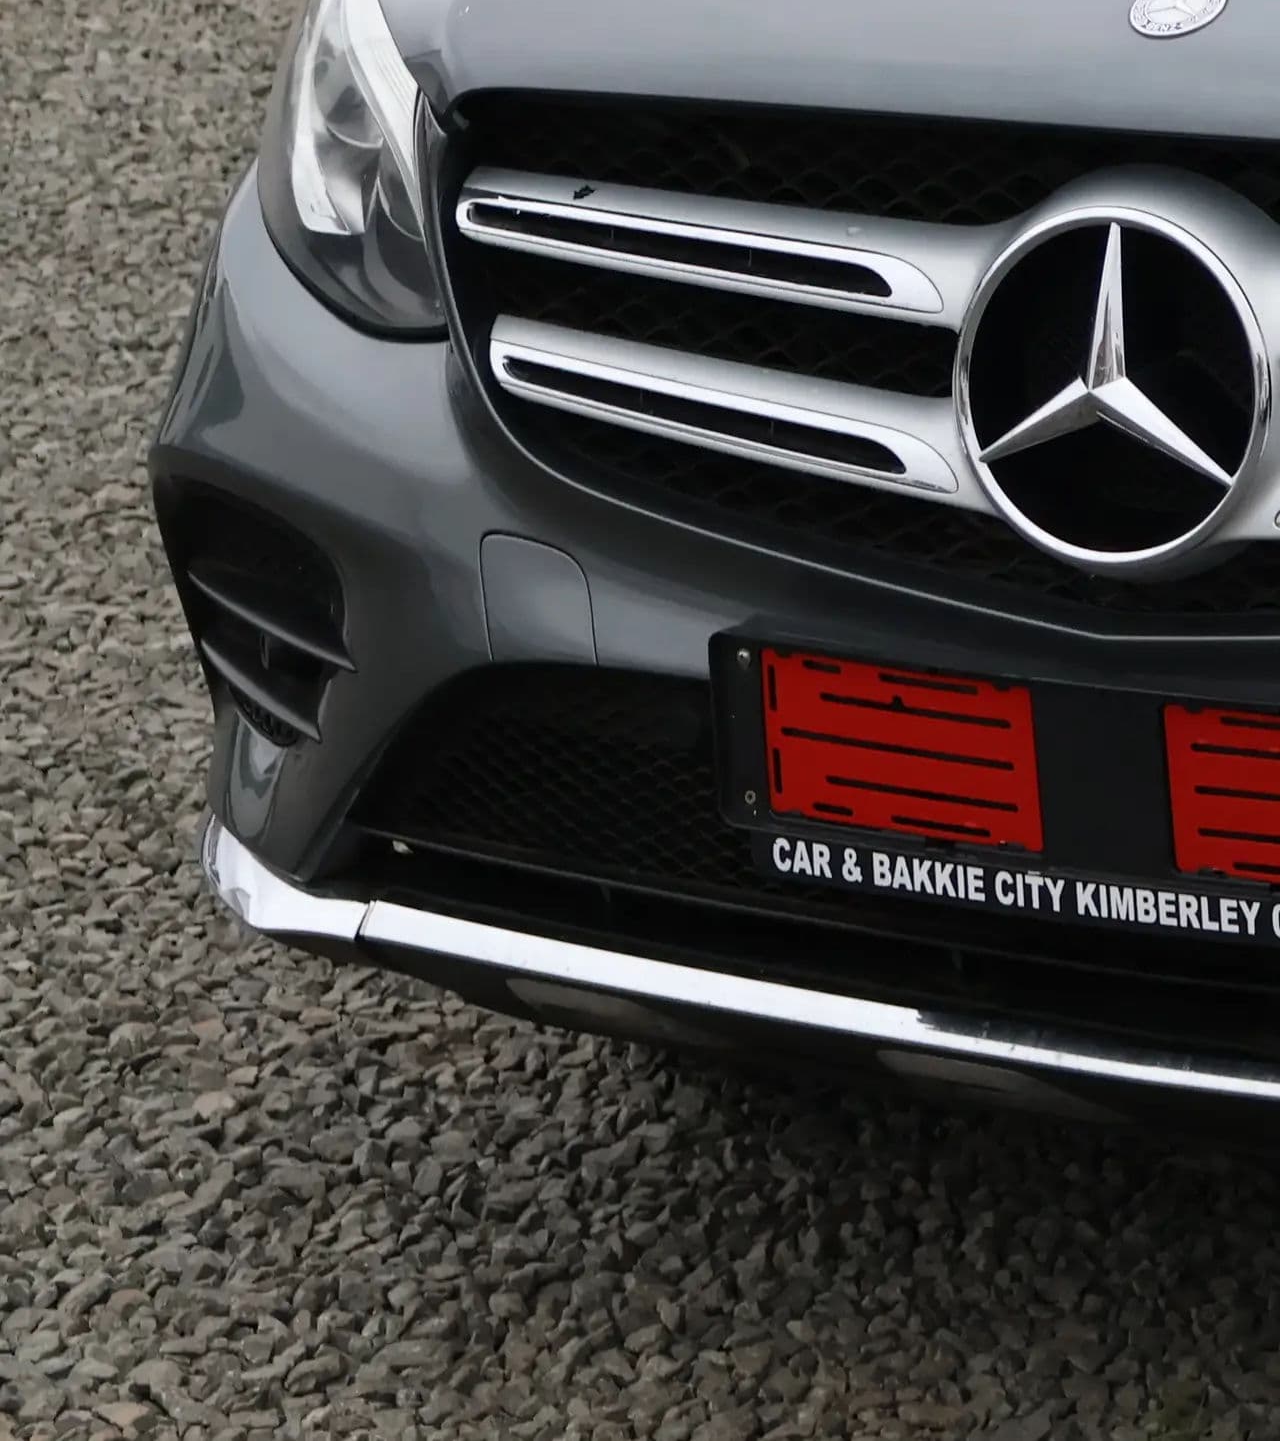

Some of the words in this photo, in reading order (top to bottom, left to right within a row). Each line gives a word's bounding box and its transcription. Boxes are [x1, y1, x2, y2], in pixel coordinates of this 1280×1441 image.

[773, 837, 832, 878] CAR
[842, 848, 863, 883] &
[872, 852, 987, 902] BAKKIE
[995, 870, 1065, 912] CITY
[1075, 882, 1261, 935] KIMBERLEY
